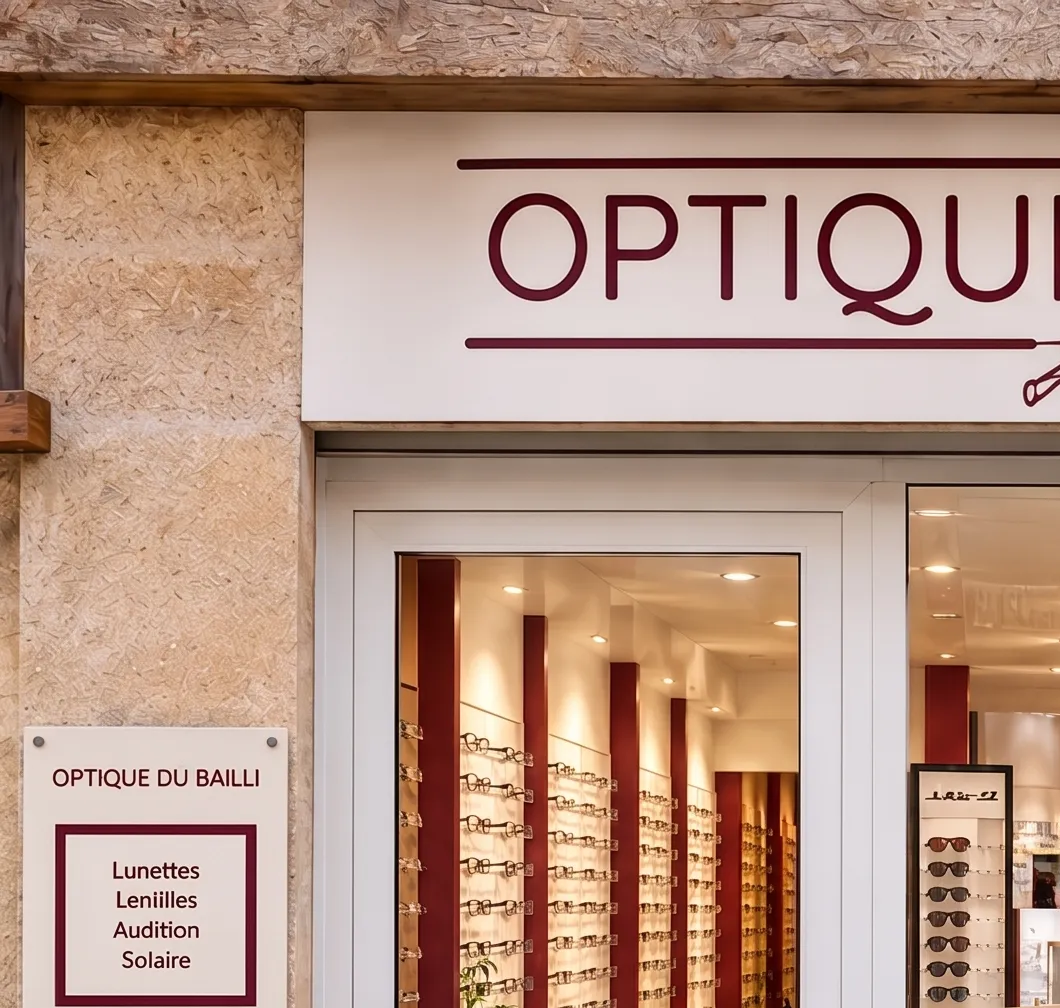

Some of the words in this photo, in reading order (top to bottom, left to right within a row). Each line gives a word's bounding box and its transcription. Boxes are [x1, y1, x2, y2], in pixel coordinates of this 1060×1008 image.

[52, 768, 150, 790] OPTIQUE
[157, 768, 188, 788] DU
[196, 768, 260, 788] BAILLI
[112, 861, 200, 880] Lunettes
[116, 890, 198, 909] Leniilles
[112, 920, 200, 939] Audition
[121, 950, 191, 969] Solaire
